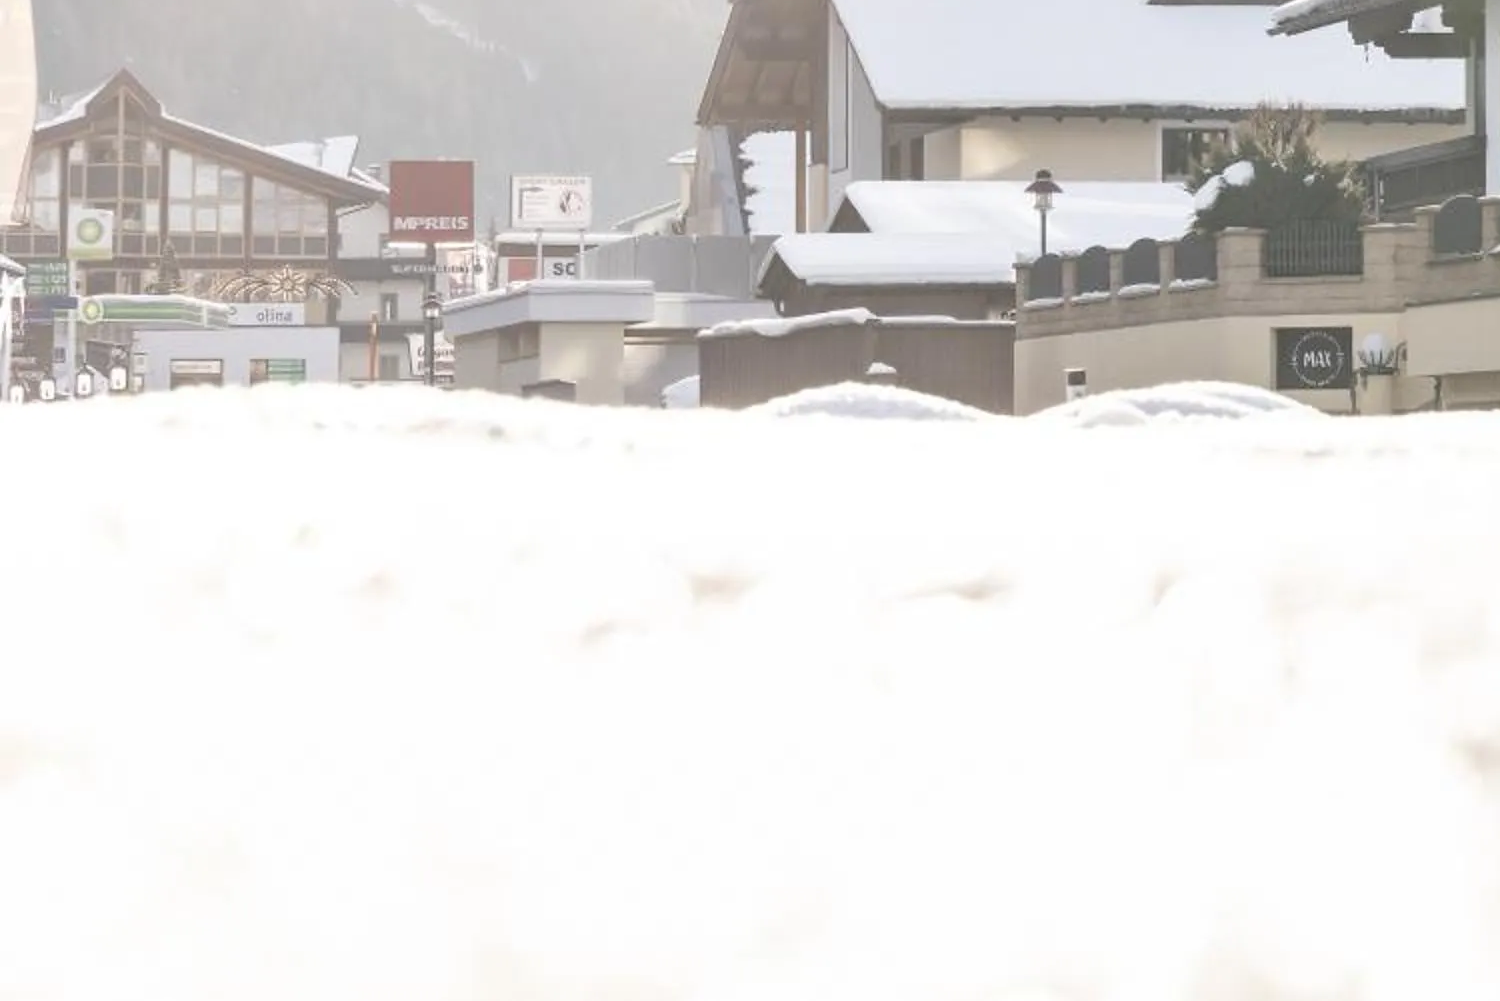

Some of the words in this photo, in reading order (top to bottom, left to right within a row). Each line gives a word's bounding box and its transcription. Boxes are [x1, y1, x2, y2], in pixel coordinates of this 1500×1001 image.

[393, 216, 469, 231] MPREIS
[255, 308, 293, 323] olina
[1303, 350, 1332, 368] MAX
